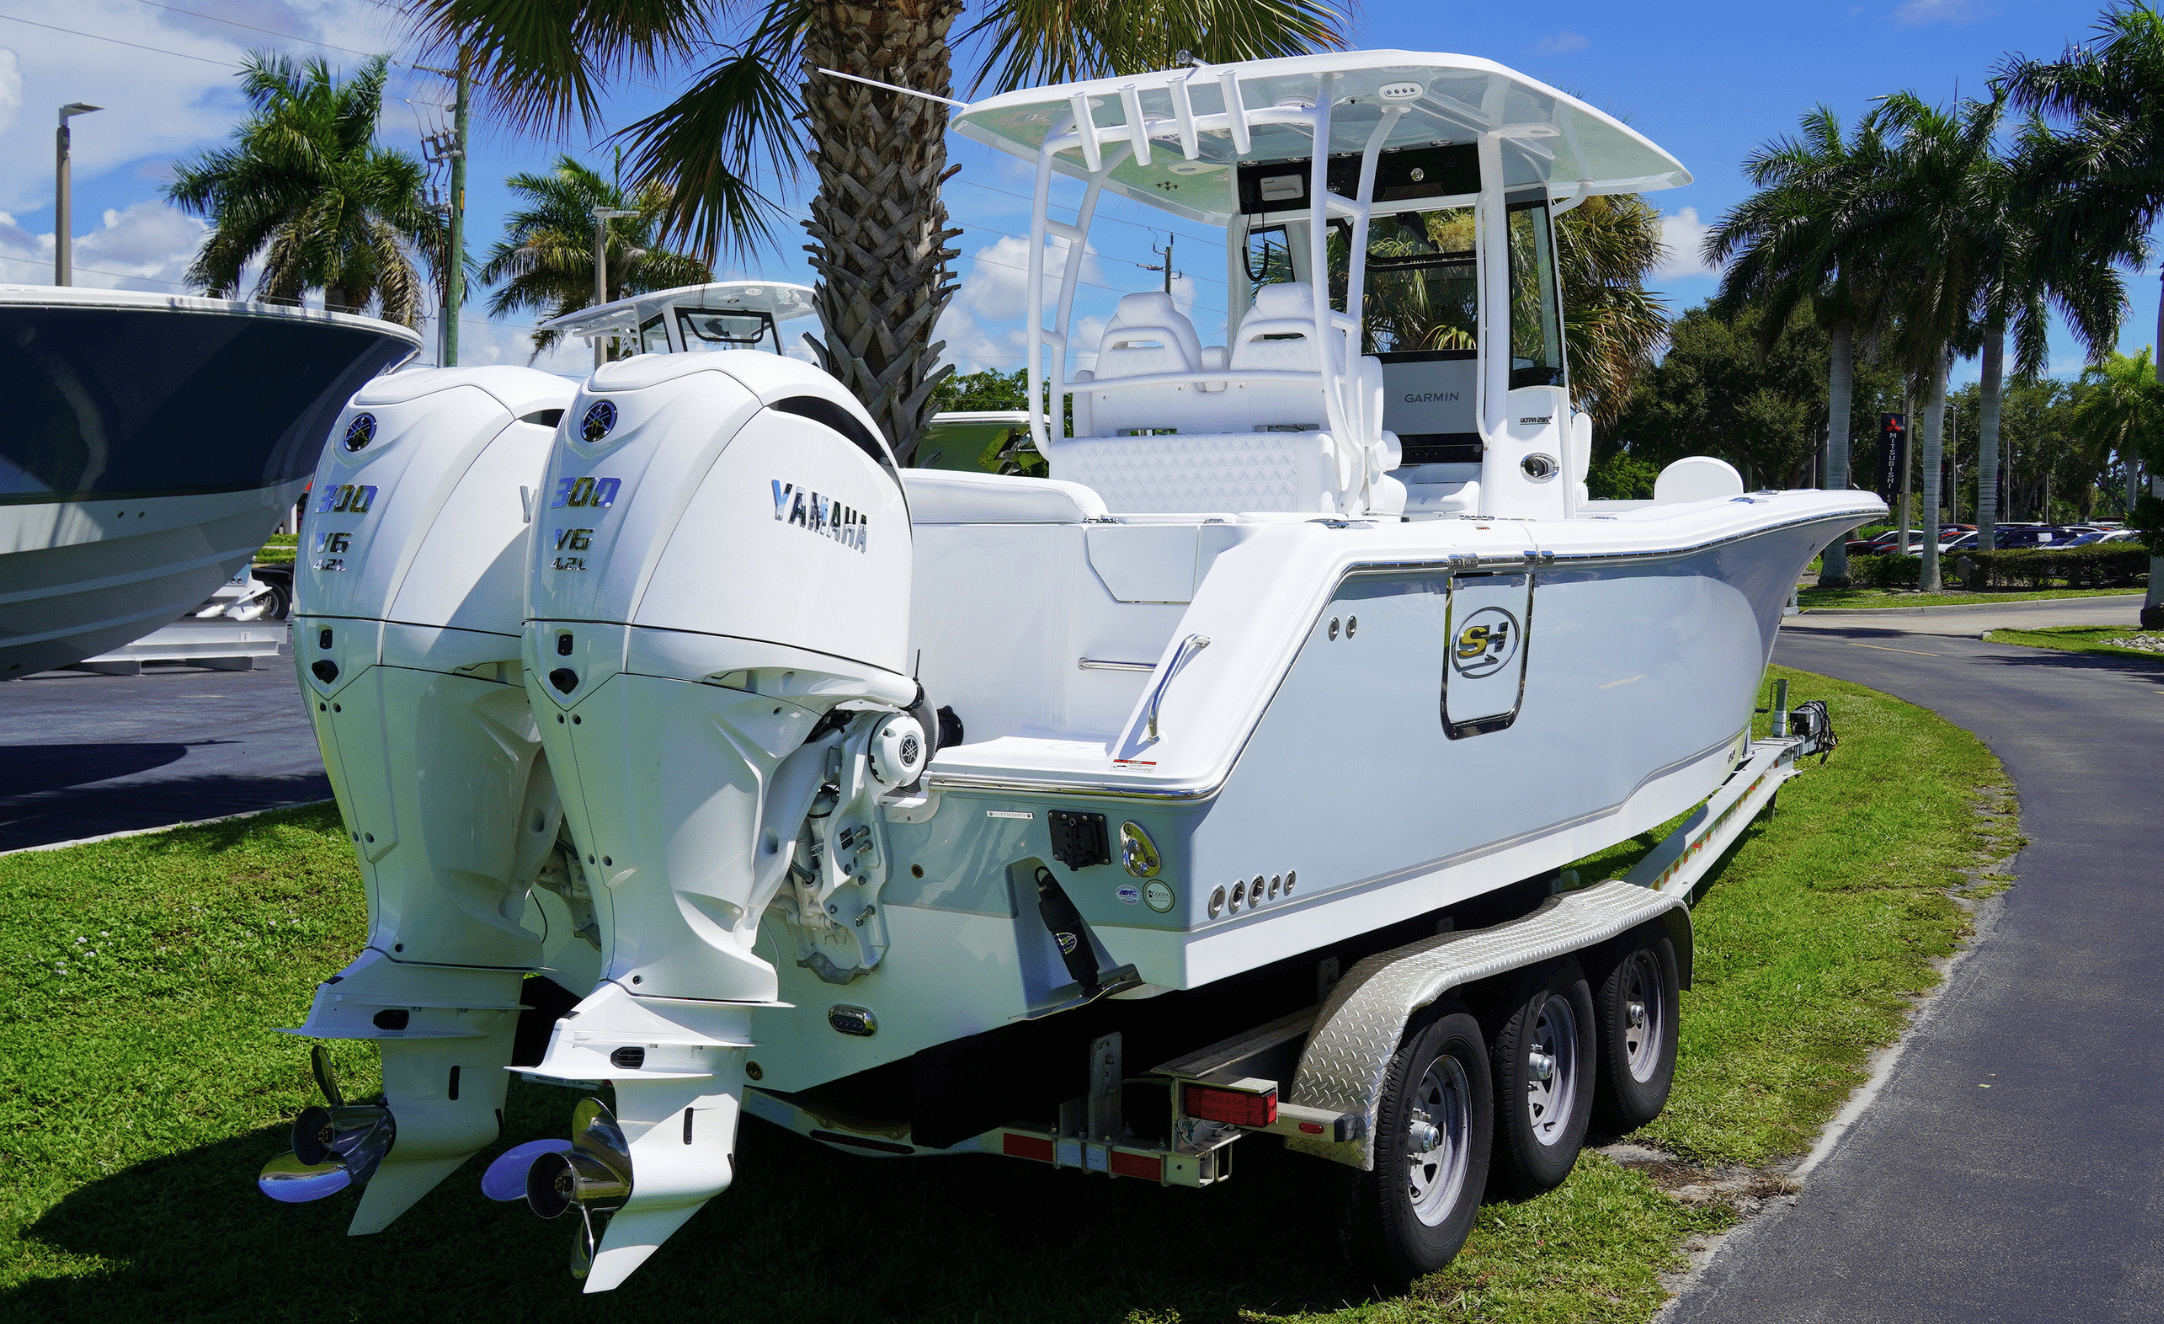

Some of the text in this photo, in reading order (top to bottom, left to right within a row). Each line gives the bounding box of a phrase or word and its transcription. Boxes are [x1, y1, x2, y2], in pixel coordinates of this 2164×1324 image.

[1404, 392, 1460, 403] GARMIN
[1886, 432, 1898, 489] MITSUBISHI
[315, 484, 379, 514] 300
[550, 476, 622, 510] 300
[770, 478, 867, 554] YAMAHA
[317, 532, 354, 554] V6
[554, 528, 595, 551] V6
